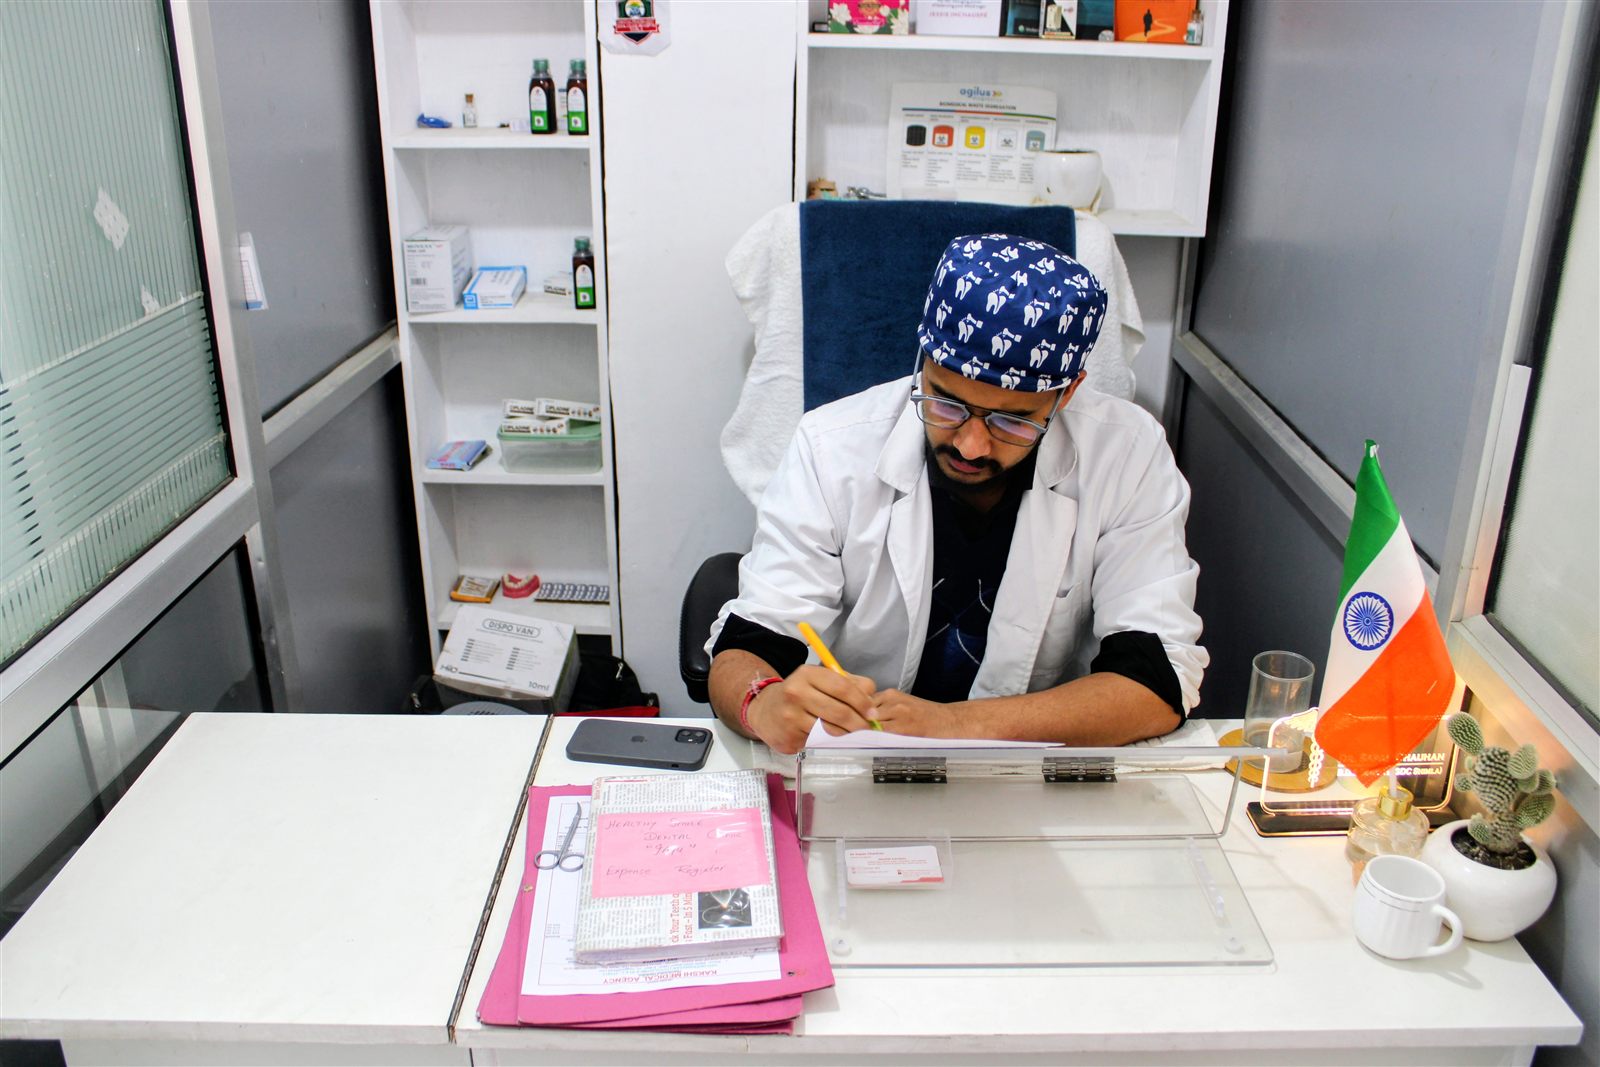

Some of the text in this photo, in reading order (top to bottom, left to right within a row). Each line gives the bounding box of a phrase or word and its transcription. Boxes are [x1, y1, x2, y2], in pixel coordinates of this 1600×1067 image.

[960, 87, 991, 97] agilus
[488, 621, 534, 635] DISPO VAN
[528, 681, 550, 691] 10ml
[1401, 752, 1445, 762] HAUHAN
[606, 865, 726, 879] Expense Register
[670, 900, 679, 918] Teeth
[670, 919, 679, 934] Your
[644, 972, 683, 981] MEDICAL
[684, 970, 717, 978] KAKSHI
